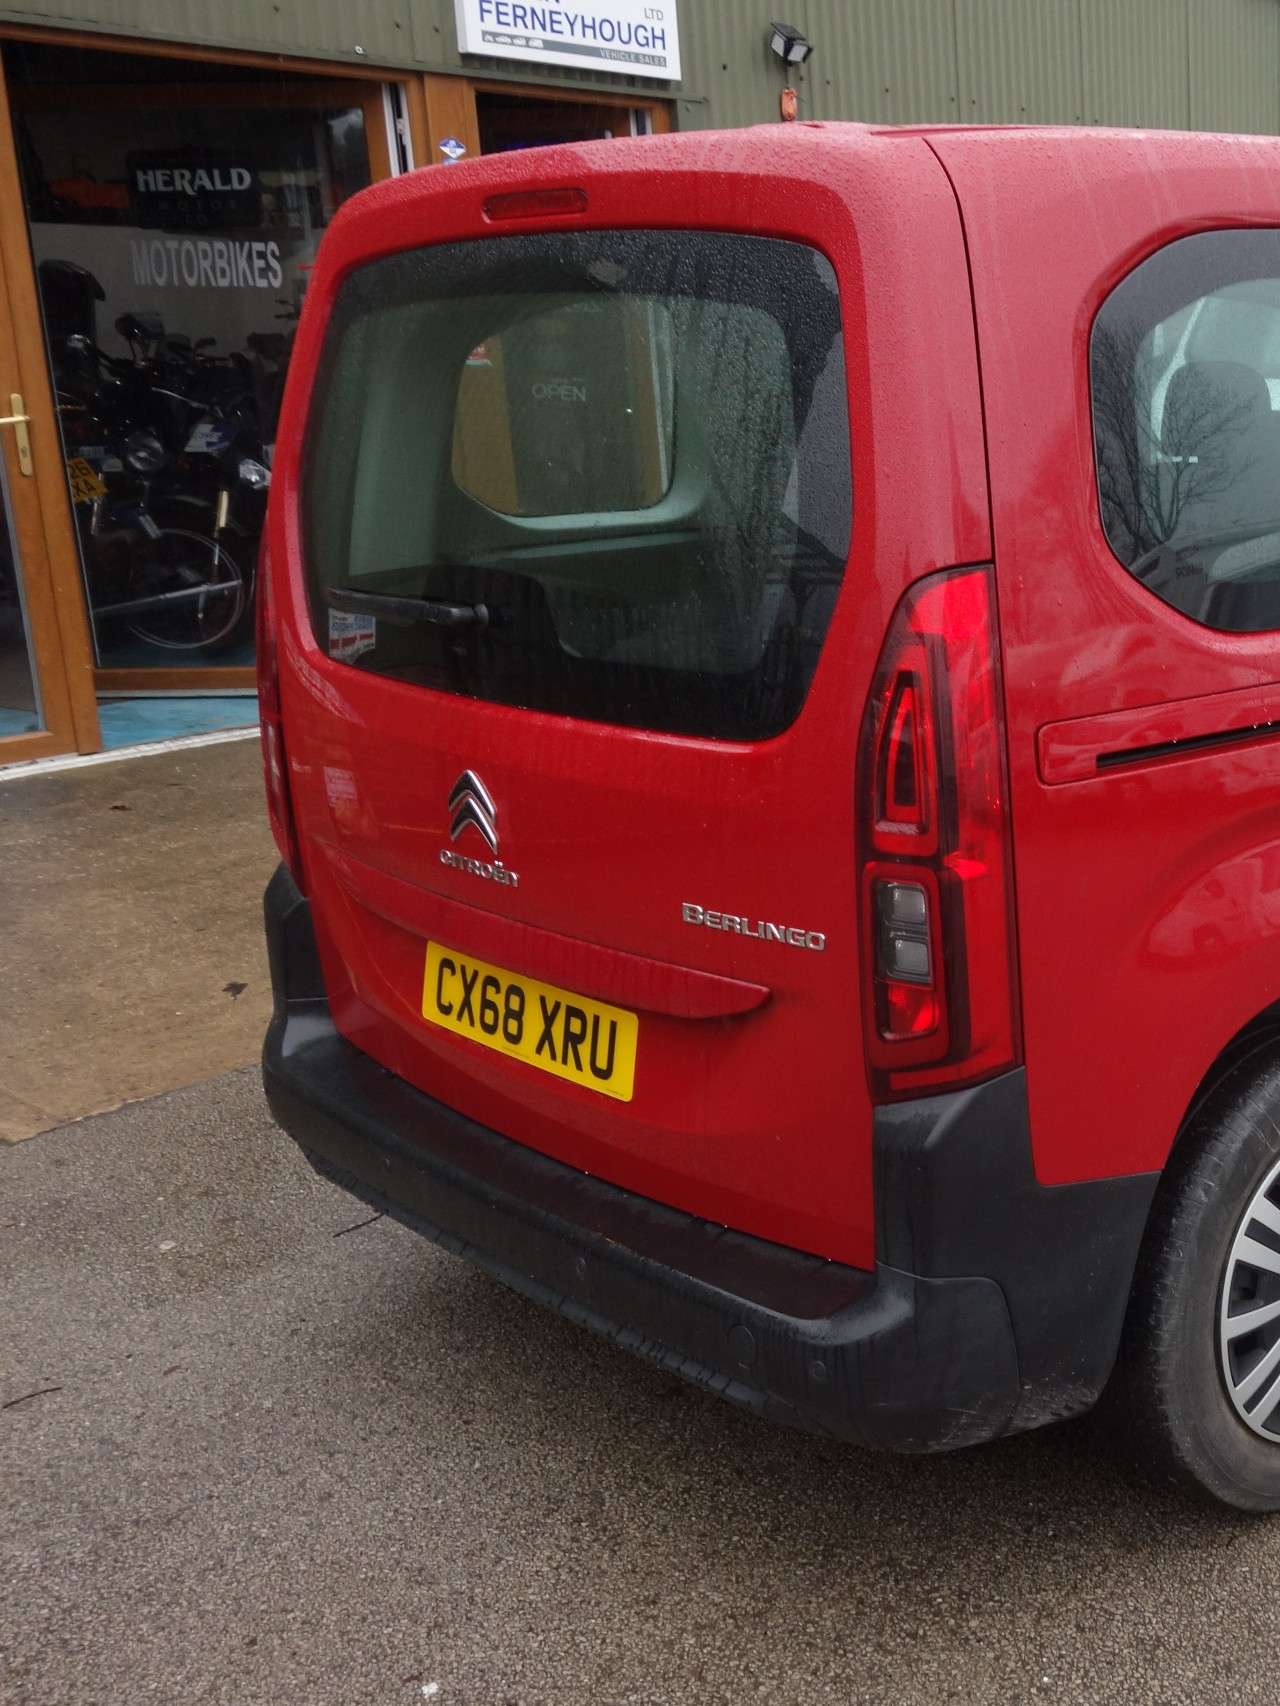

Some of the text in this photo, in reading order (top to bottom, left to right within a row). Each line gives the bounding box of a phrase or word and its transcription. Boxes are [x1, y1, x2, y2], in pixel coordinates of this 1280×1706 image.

[479, 0, 667, 50] FERNEYHOUGH
[643, 7, 664, 21] LTD
[600, 48, 667, 67] VEHICLE SALES
[136, 167, 252, 196] HERALD
[131, 240, 283, 289] MOTORBIKES
[531, 383, 587, 402] OPEN
[682, 902, 826, 951] BERLINGO
[436, 957, 618, 1081] CX68 XRU
